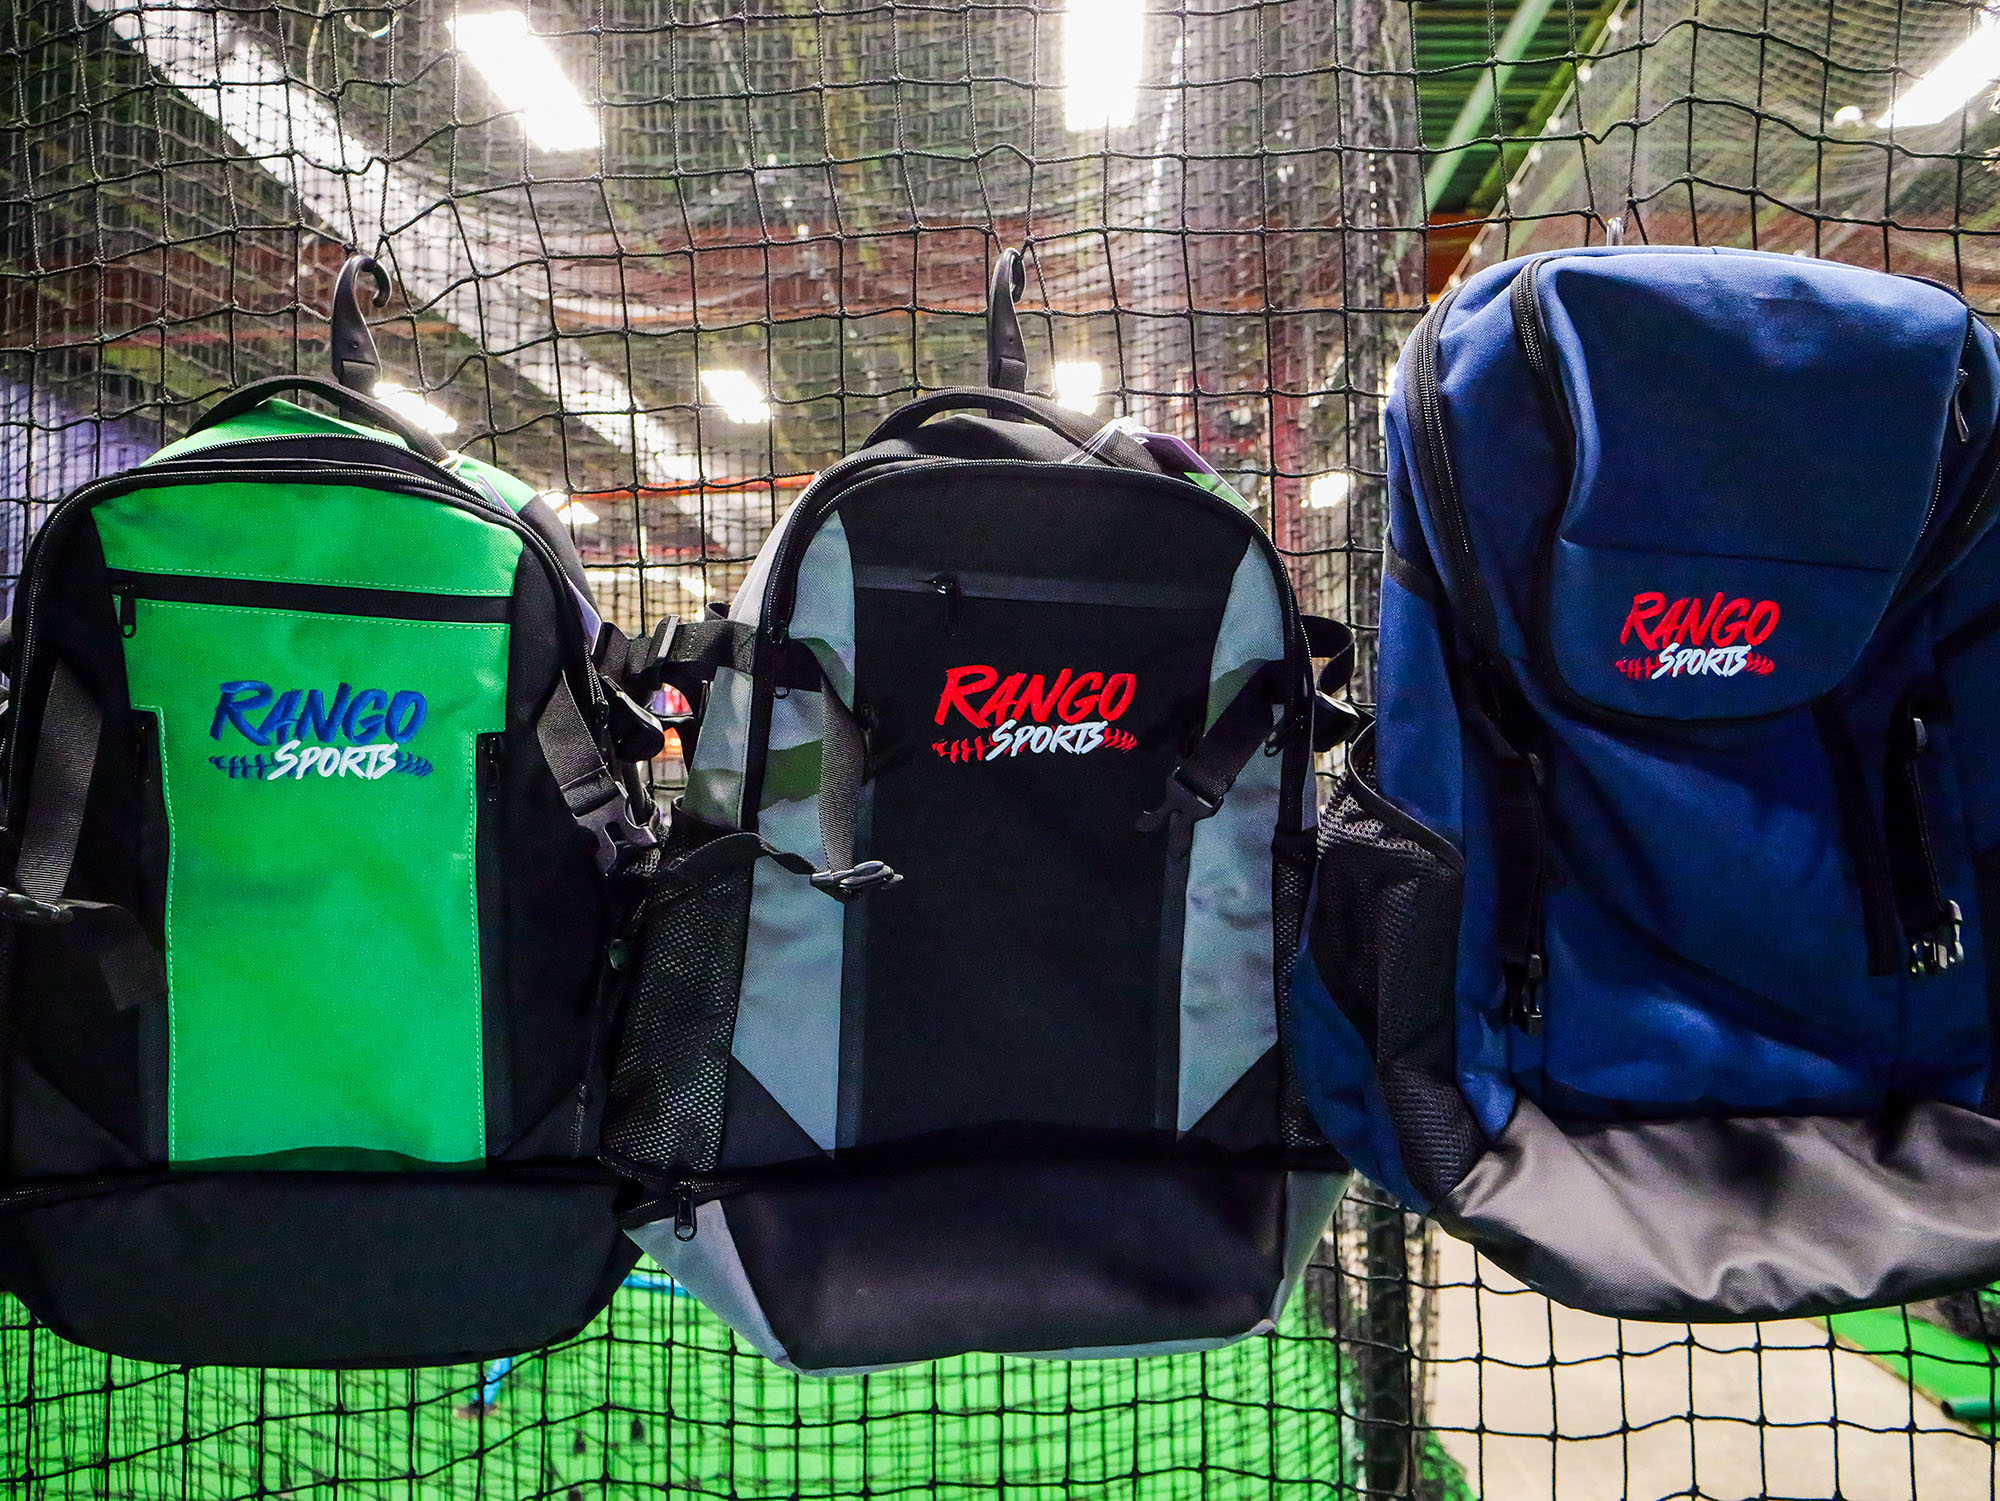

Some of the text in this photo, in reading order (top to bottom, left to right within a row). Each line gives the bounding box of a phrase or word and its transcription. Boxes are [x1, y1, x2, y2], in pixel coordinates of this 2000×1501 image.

[1619, 592, 1780, 650] RANGO
[1651, 642, 1752, 680] SPORTS
[209, 680, 428, 746] RANGO
[934, 664, 1136, 728] RANGO
[267, 740, 399, 780] SPORTS
[985, 719, 1108, 761] SPORTS
